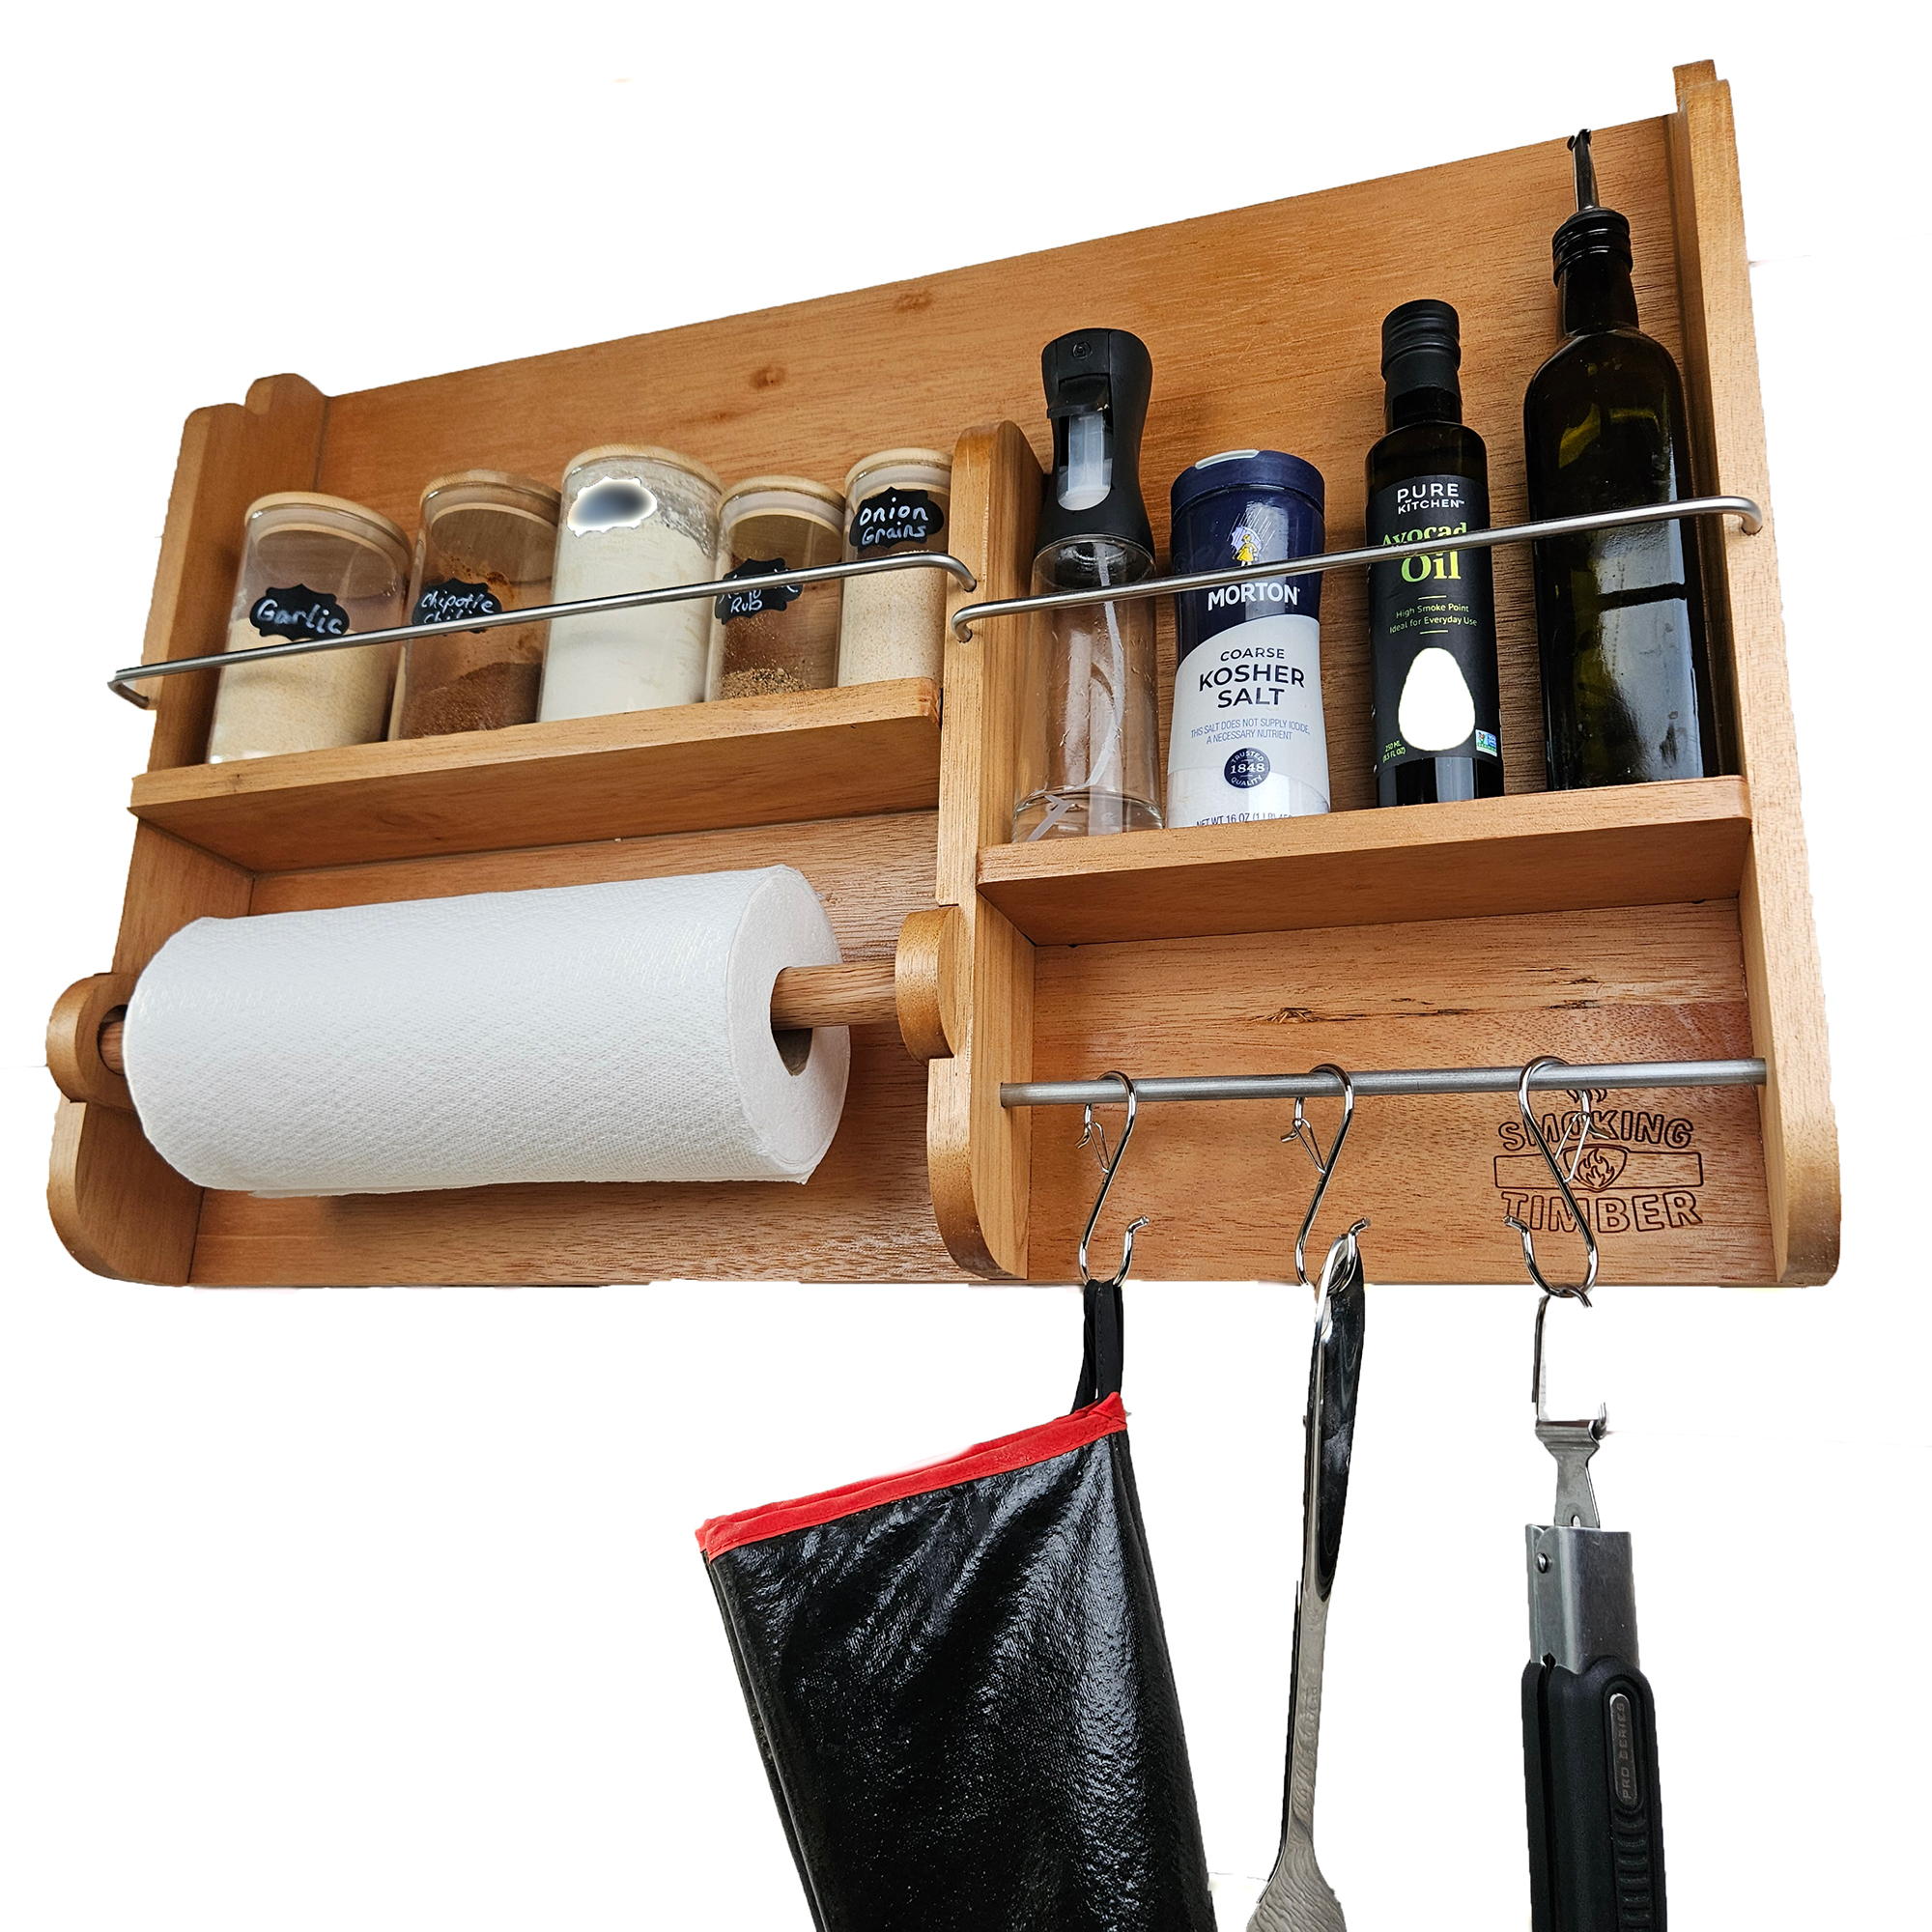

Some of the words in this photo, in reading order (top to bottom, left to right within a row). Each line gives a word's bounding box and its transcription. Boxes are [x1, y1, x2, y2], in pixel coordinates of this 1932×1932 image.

[1397, 483, 1460, 503] PURE
[859, 497, 929, 526] Onion
[862, 522, 927, 546] Grains
[1382, 522, 1468, 547] Avocad
[1401, 551, 1462, 582] Oil
[421, 590, 495, 614] Chipotle
[730, 591, 763, 613] Rub
[1208, 582, 1298, 611] MORTON
[257, 599, 343, 636] Garlic
[1396, 607, 1415, 618] High
[1417, 603, 1447, 613] Smoke
[1448, 602, 1469, 612] Point
[1389, 621, 1408, 634] Ideal
[1410, 618, 1422, 627] for
[1424, 615, 1463, 626] Everyday
[1463, 616, 1478, 627] Use
[1220, 647, 1286, 662] COARSE
[1199, 664, 1305, 692] KOSHER
[1217, 687, 1285, 709] SALT
[1191, 726, 1204, 739] THIS
[1204, 722, 1220, 734] SALT
[1221, 719, 1241, 730] DOES
[1242, 718, 1259, 727] NOT
[1260, 718, 1288, 728] SUPPLY
[1206, 735, 1212, 745] A
[1213, 729, 1256, 743] NECESSARY
[1257, 729, 1293, 740] NUTRIENT
[1230, 750, 1264, 763] TRUSTED
[1230, 762, 1265, 774] 1848
[1231, 774, 1263, 786] QUALITY
[1210, 815, 1224, 825] WT
[1226, 813, 1237, 823] 16
[1498, 1110, 1694, 1151] SMOKING
[1501, 1190, 1703, 1234] TIMBER
